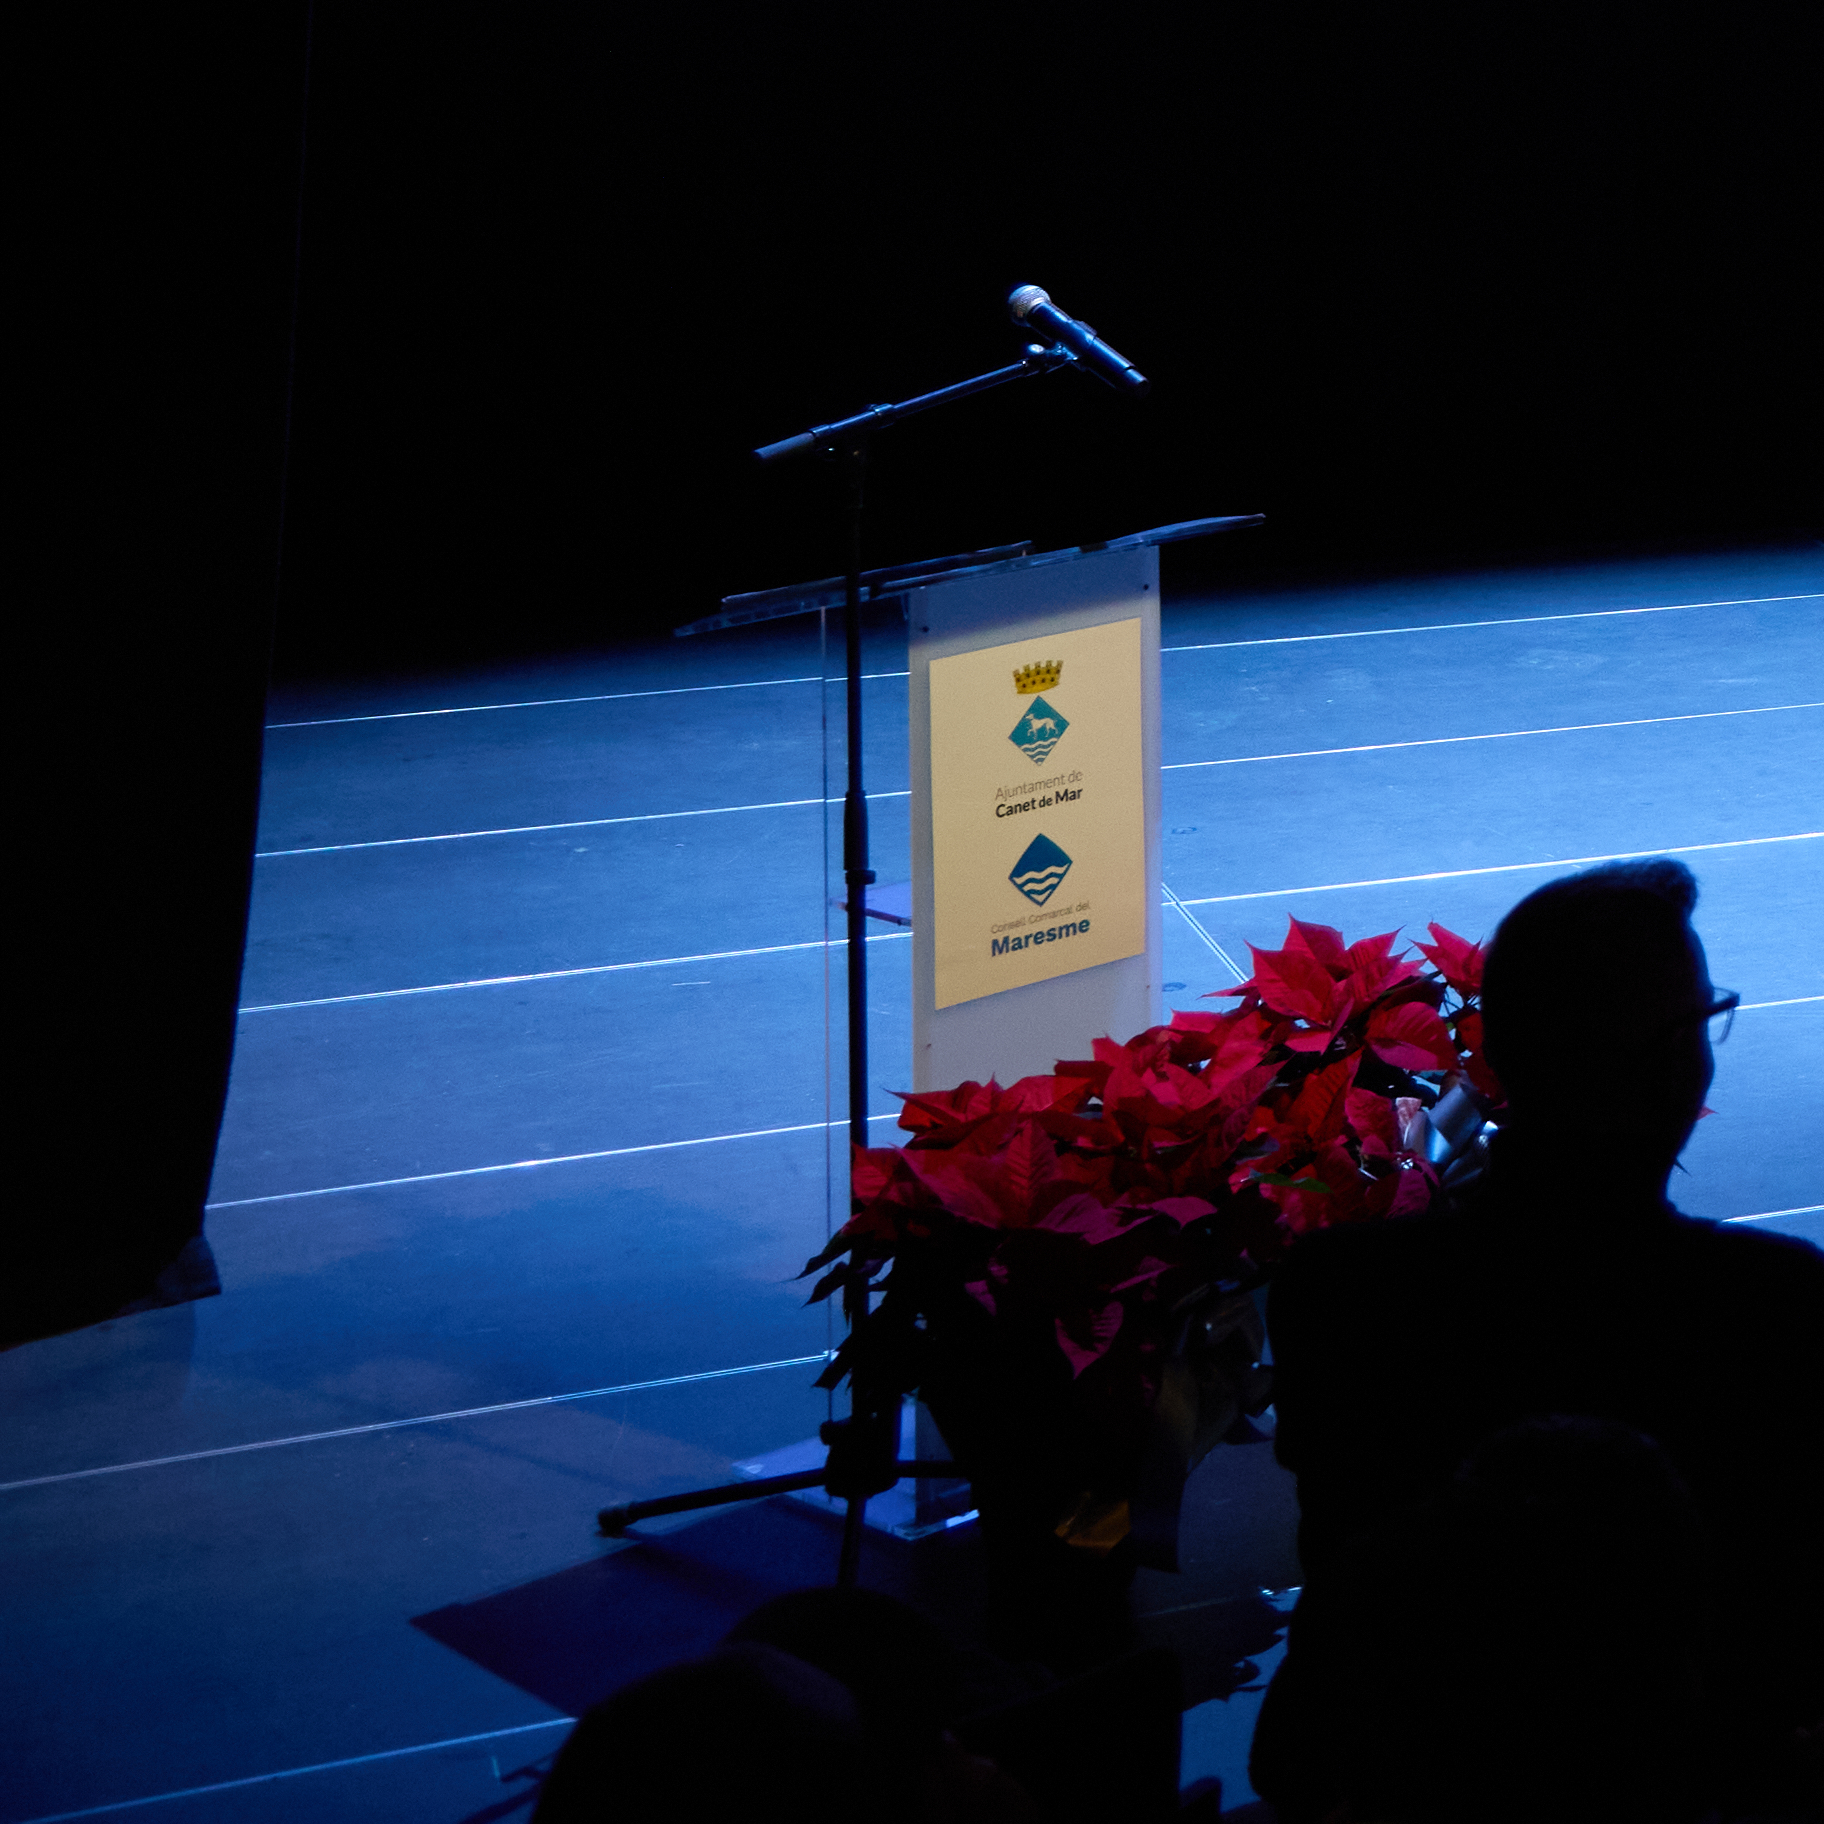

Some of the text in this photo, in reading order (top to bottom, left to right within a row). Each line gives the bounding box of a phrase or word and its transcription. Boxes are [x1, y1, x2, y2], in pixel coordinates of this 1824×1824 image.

[995, 770, 1083, 802] Ajuntament de
[995, 788, 1083, 818] Canet de Mar
[991, 917, 1027, 934] Consell
[1077, 900, 1090, 912] del
[991, 919, 1091, 957] Maresme
